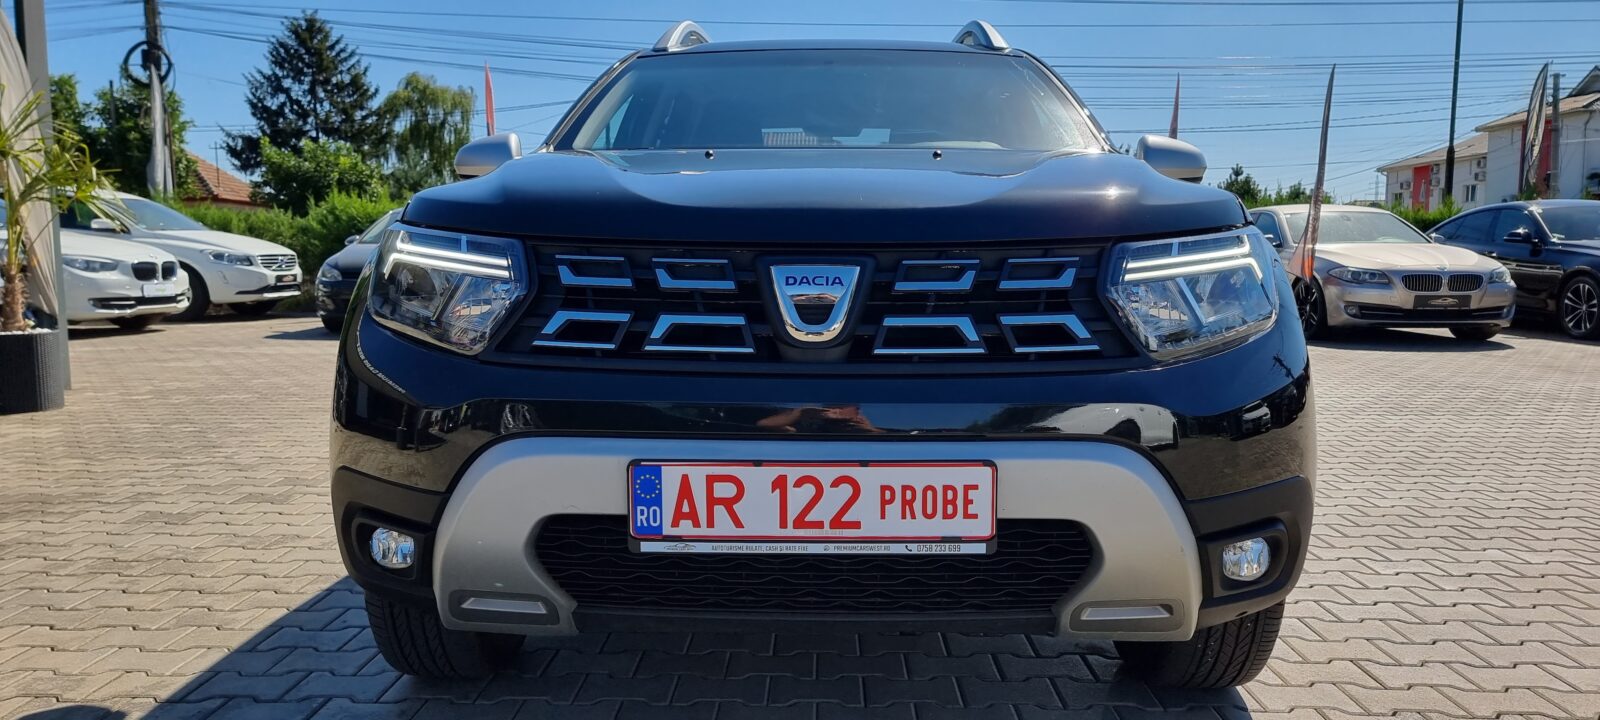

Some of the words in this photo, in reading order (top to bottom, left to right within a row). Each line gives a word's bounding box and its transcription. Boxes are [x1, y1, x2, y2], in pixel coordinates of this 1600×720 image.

[785, 276, 844, 286] DACIA
[670, 474, 745, 528] AR
[771, 474, 861, 529] 122
[880, 484, 979, 520] PROBE
[636, 506, 661, 526] RO
